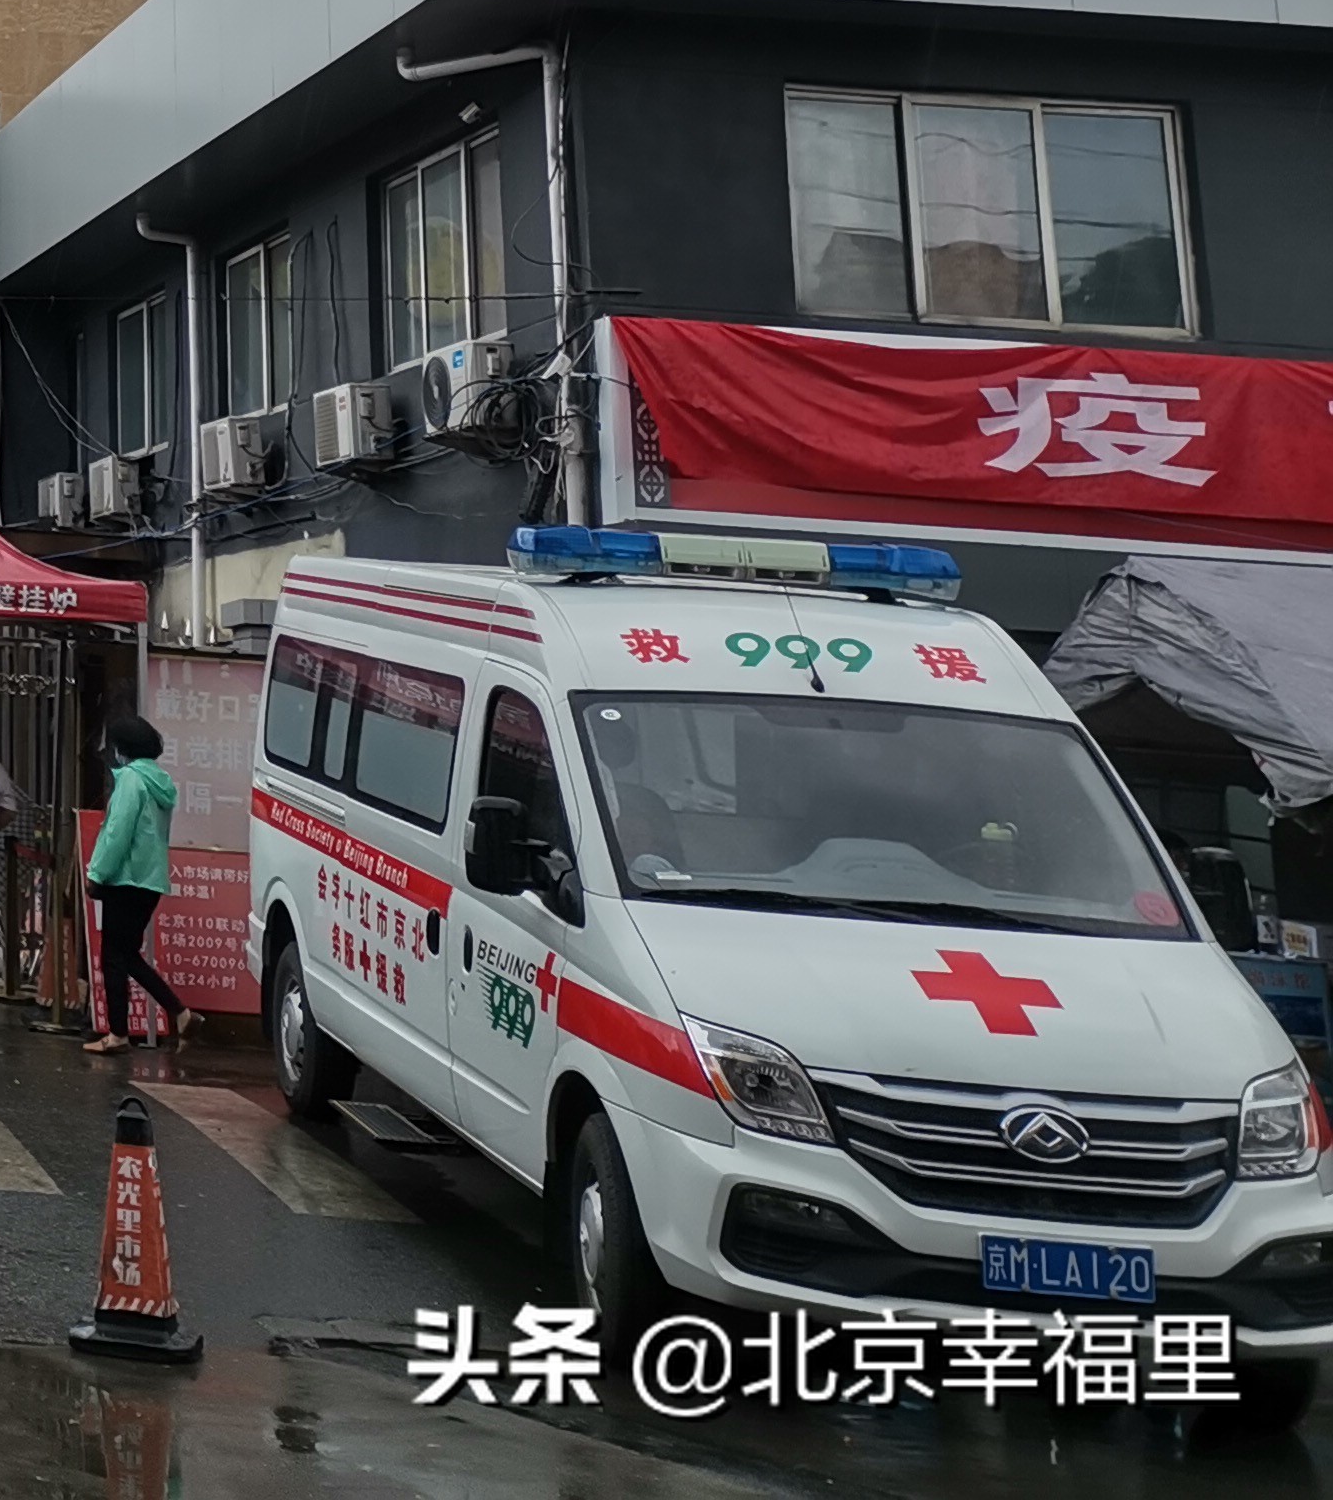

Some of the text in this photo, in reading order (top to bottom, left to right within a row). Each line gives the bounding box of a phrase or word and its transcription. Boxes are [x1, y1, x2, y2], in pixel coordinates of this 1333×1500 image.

[977, 372, 1219, 487] 疫
[620, 627, 987, 684] 救 999 援
[285, 808, 305, 836] Cross
[343, 839, 375, 877] Beijing
[375, 854, 409, 890] Branch
[476, 938, 537, 985] BEIJING
[112, 1155, 142, 1287] 农光里市场
